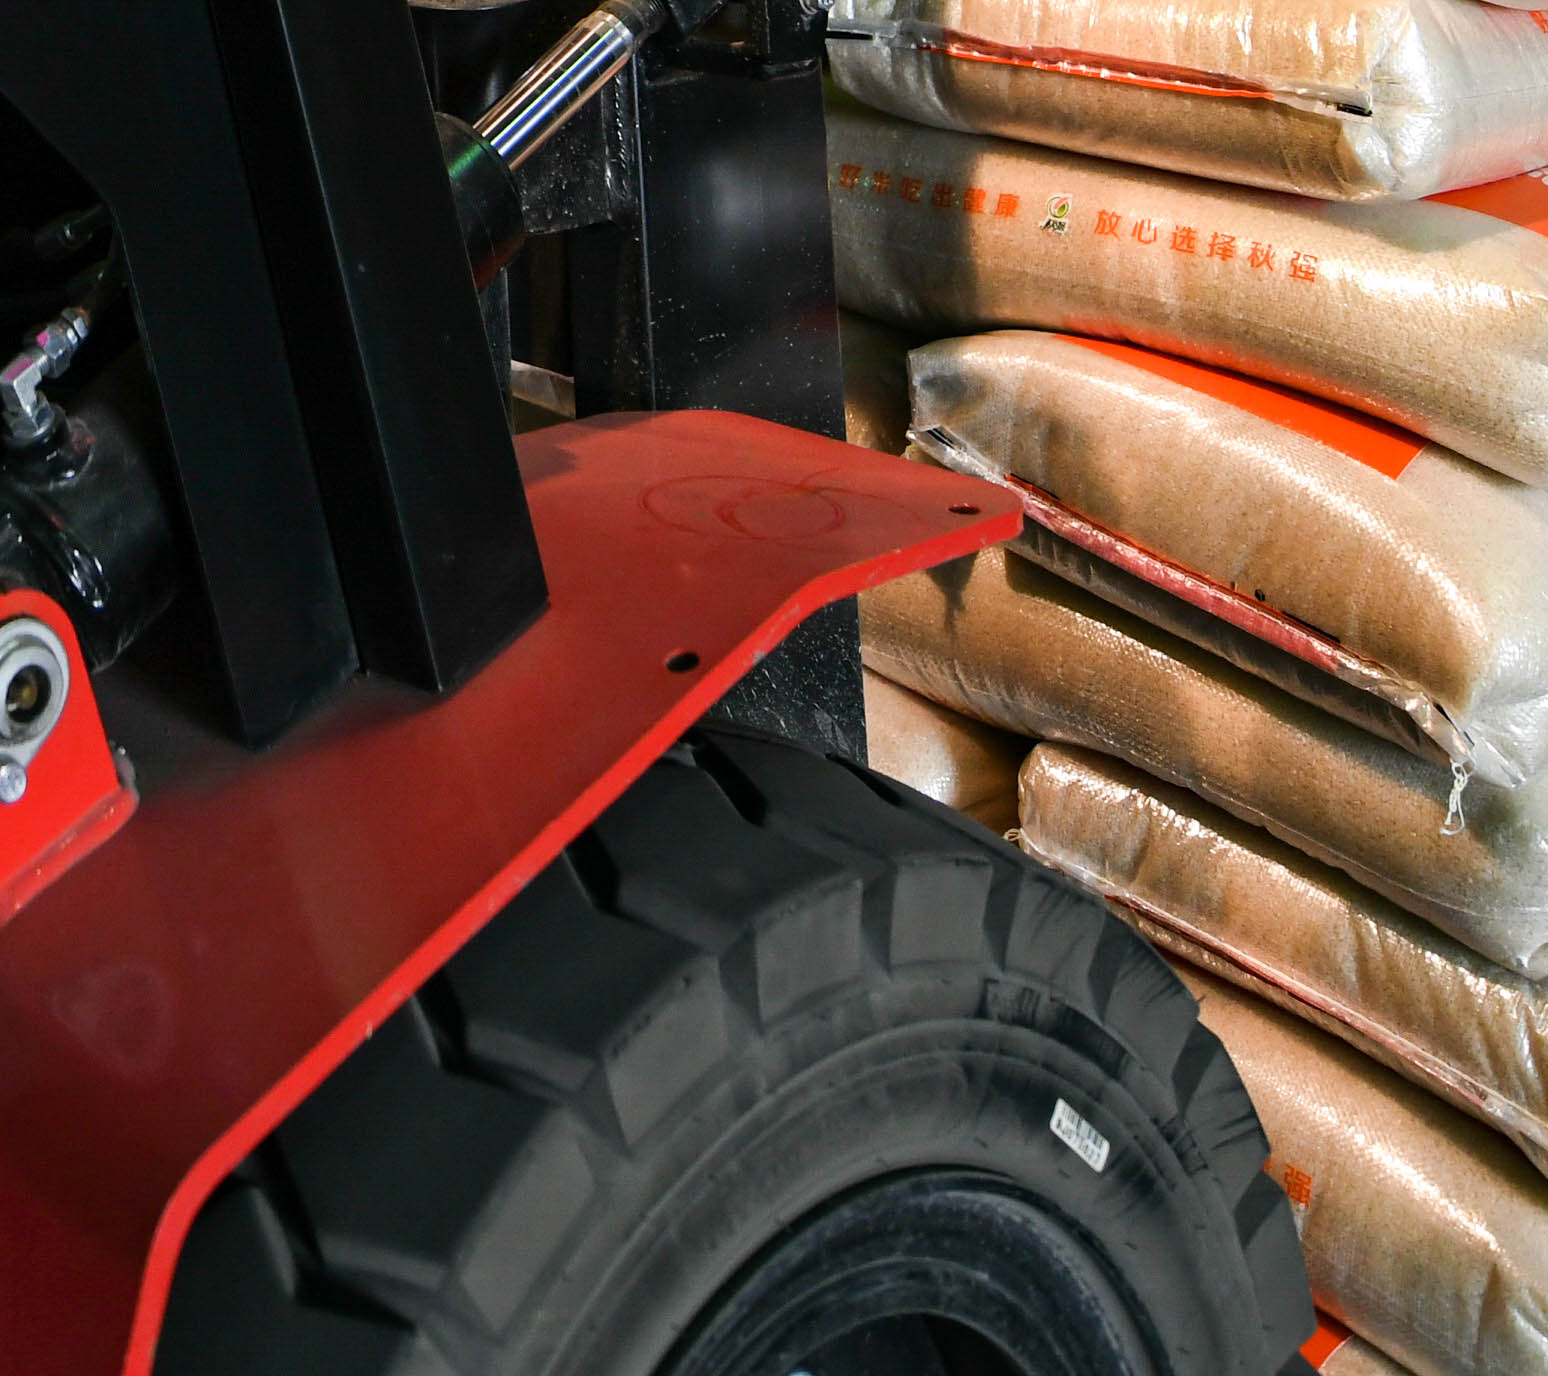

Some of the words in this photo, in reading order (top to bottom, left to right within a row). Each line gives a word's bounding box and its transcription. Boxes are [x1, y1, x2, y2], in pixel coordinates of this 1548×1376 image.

[1092, 209, 1318, 283] 放心选择秋强
